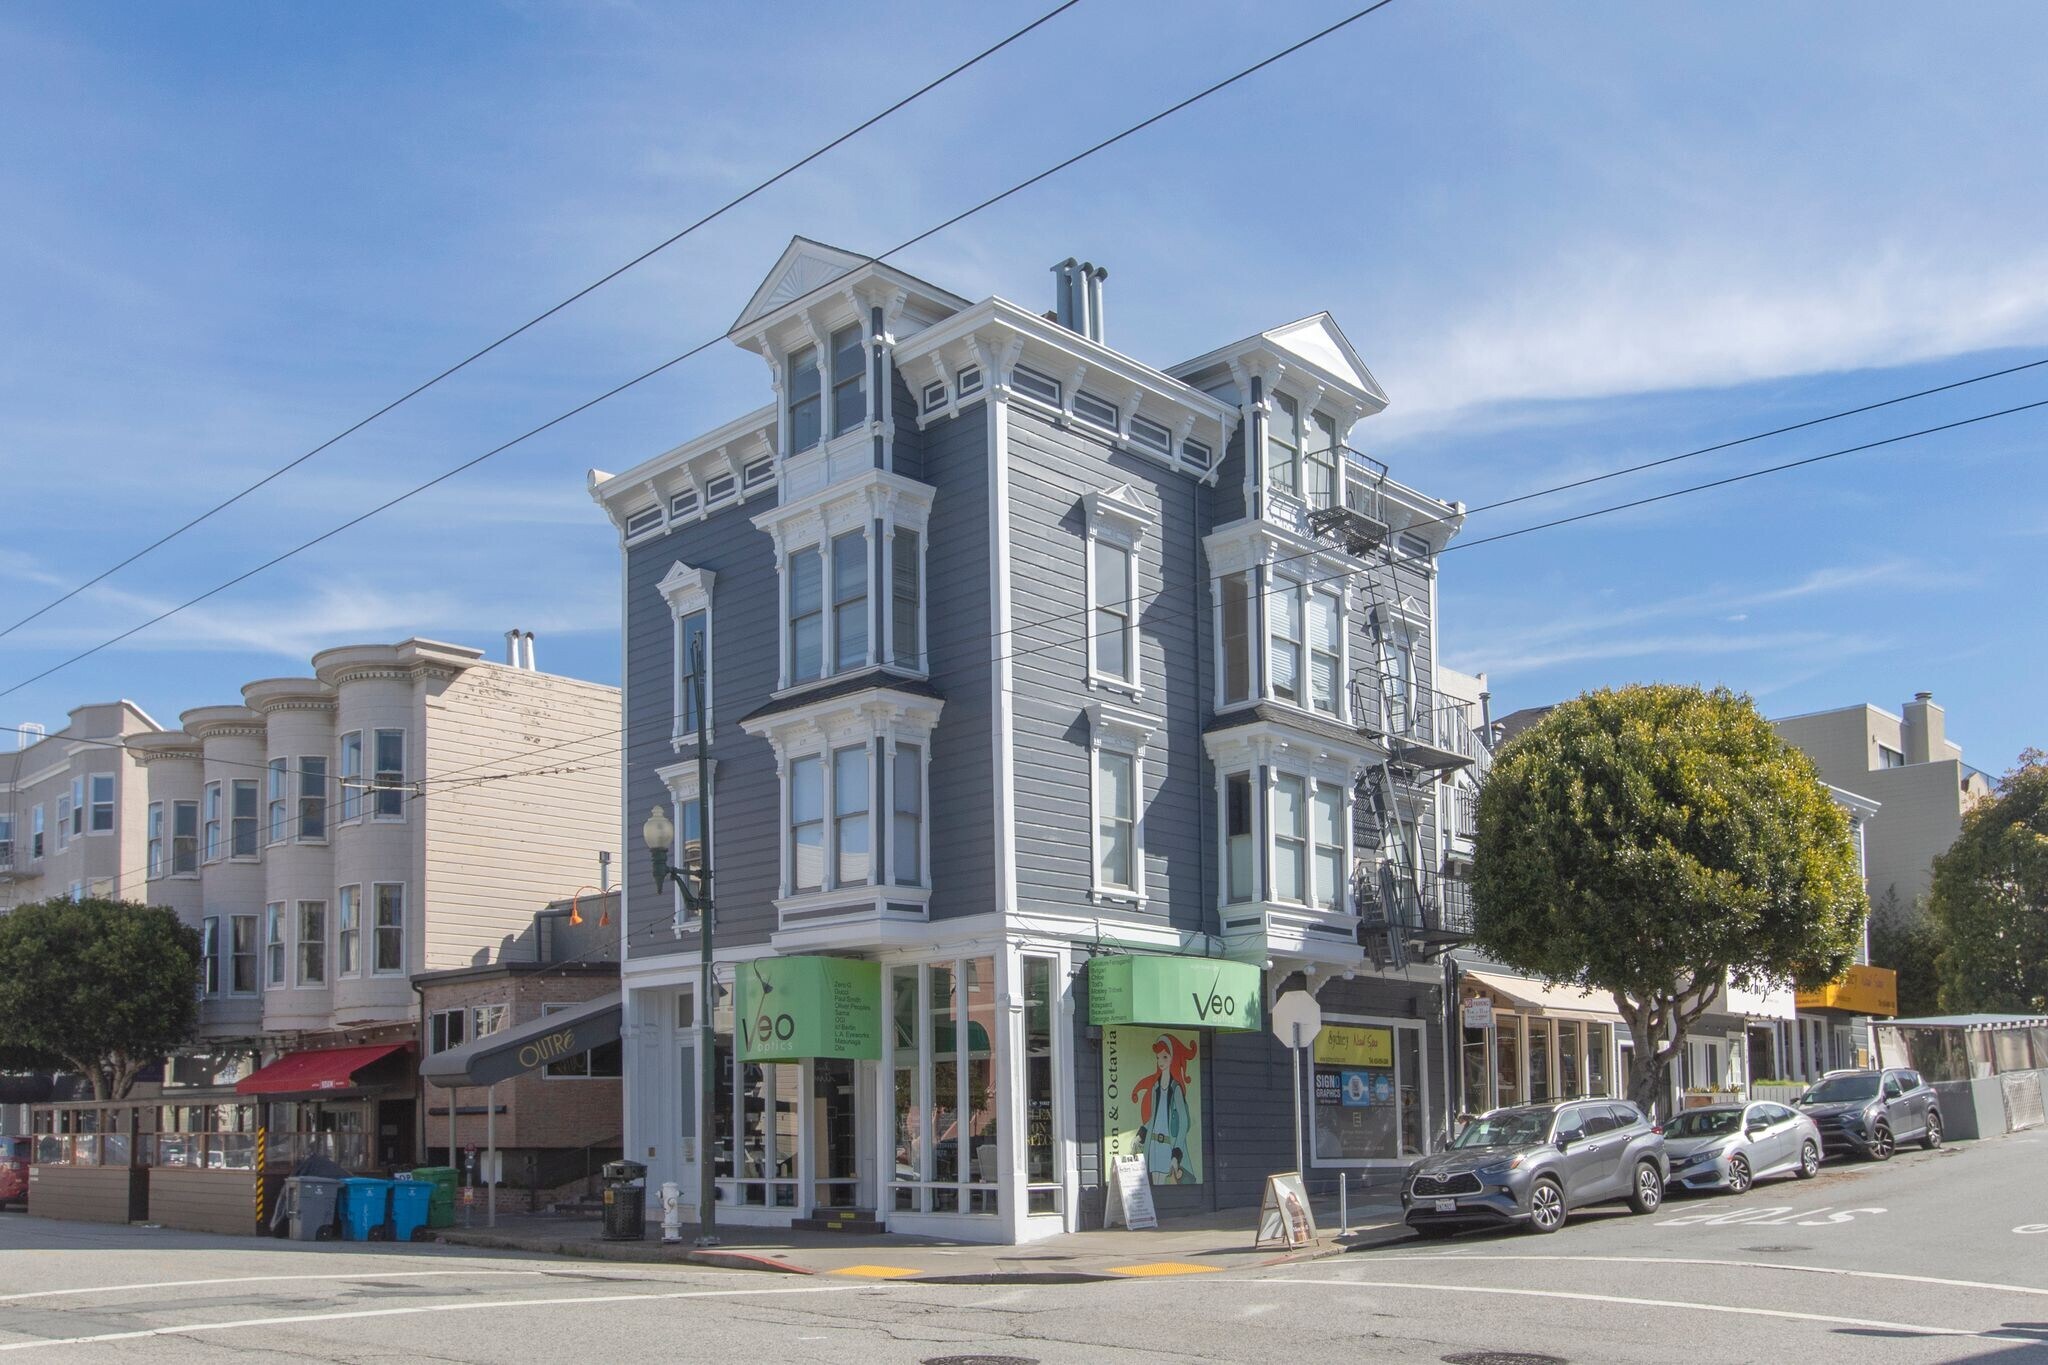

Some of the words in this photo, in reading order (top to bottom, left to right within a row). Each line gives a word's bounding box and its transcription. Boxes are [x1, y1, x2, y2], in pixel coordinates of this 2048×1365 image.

[1192, 968, 1235, 1021] Veo
[742, 980, 795, 1054] Veo
[757, 1040, 793, 1054] optics
[1107, 1029, 1120, 1099] Octavia
[1315, 1088, 1341, 1098] GRAPHICS
[1108, 1106, 1120, 1121] &
[1108, 1127, 1120, 1156] ion
[1653, 1206, 1888, 1226] STOP
